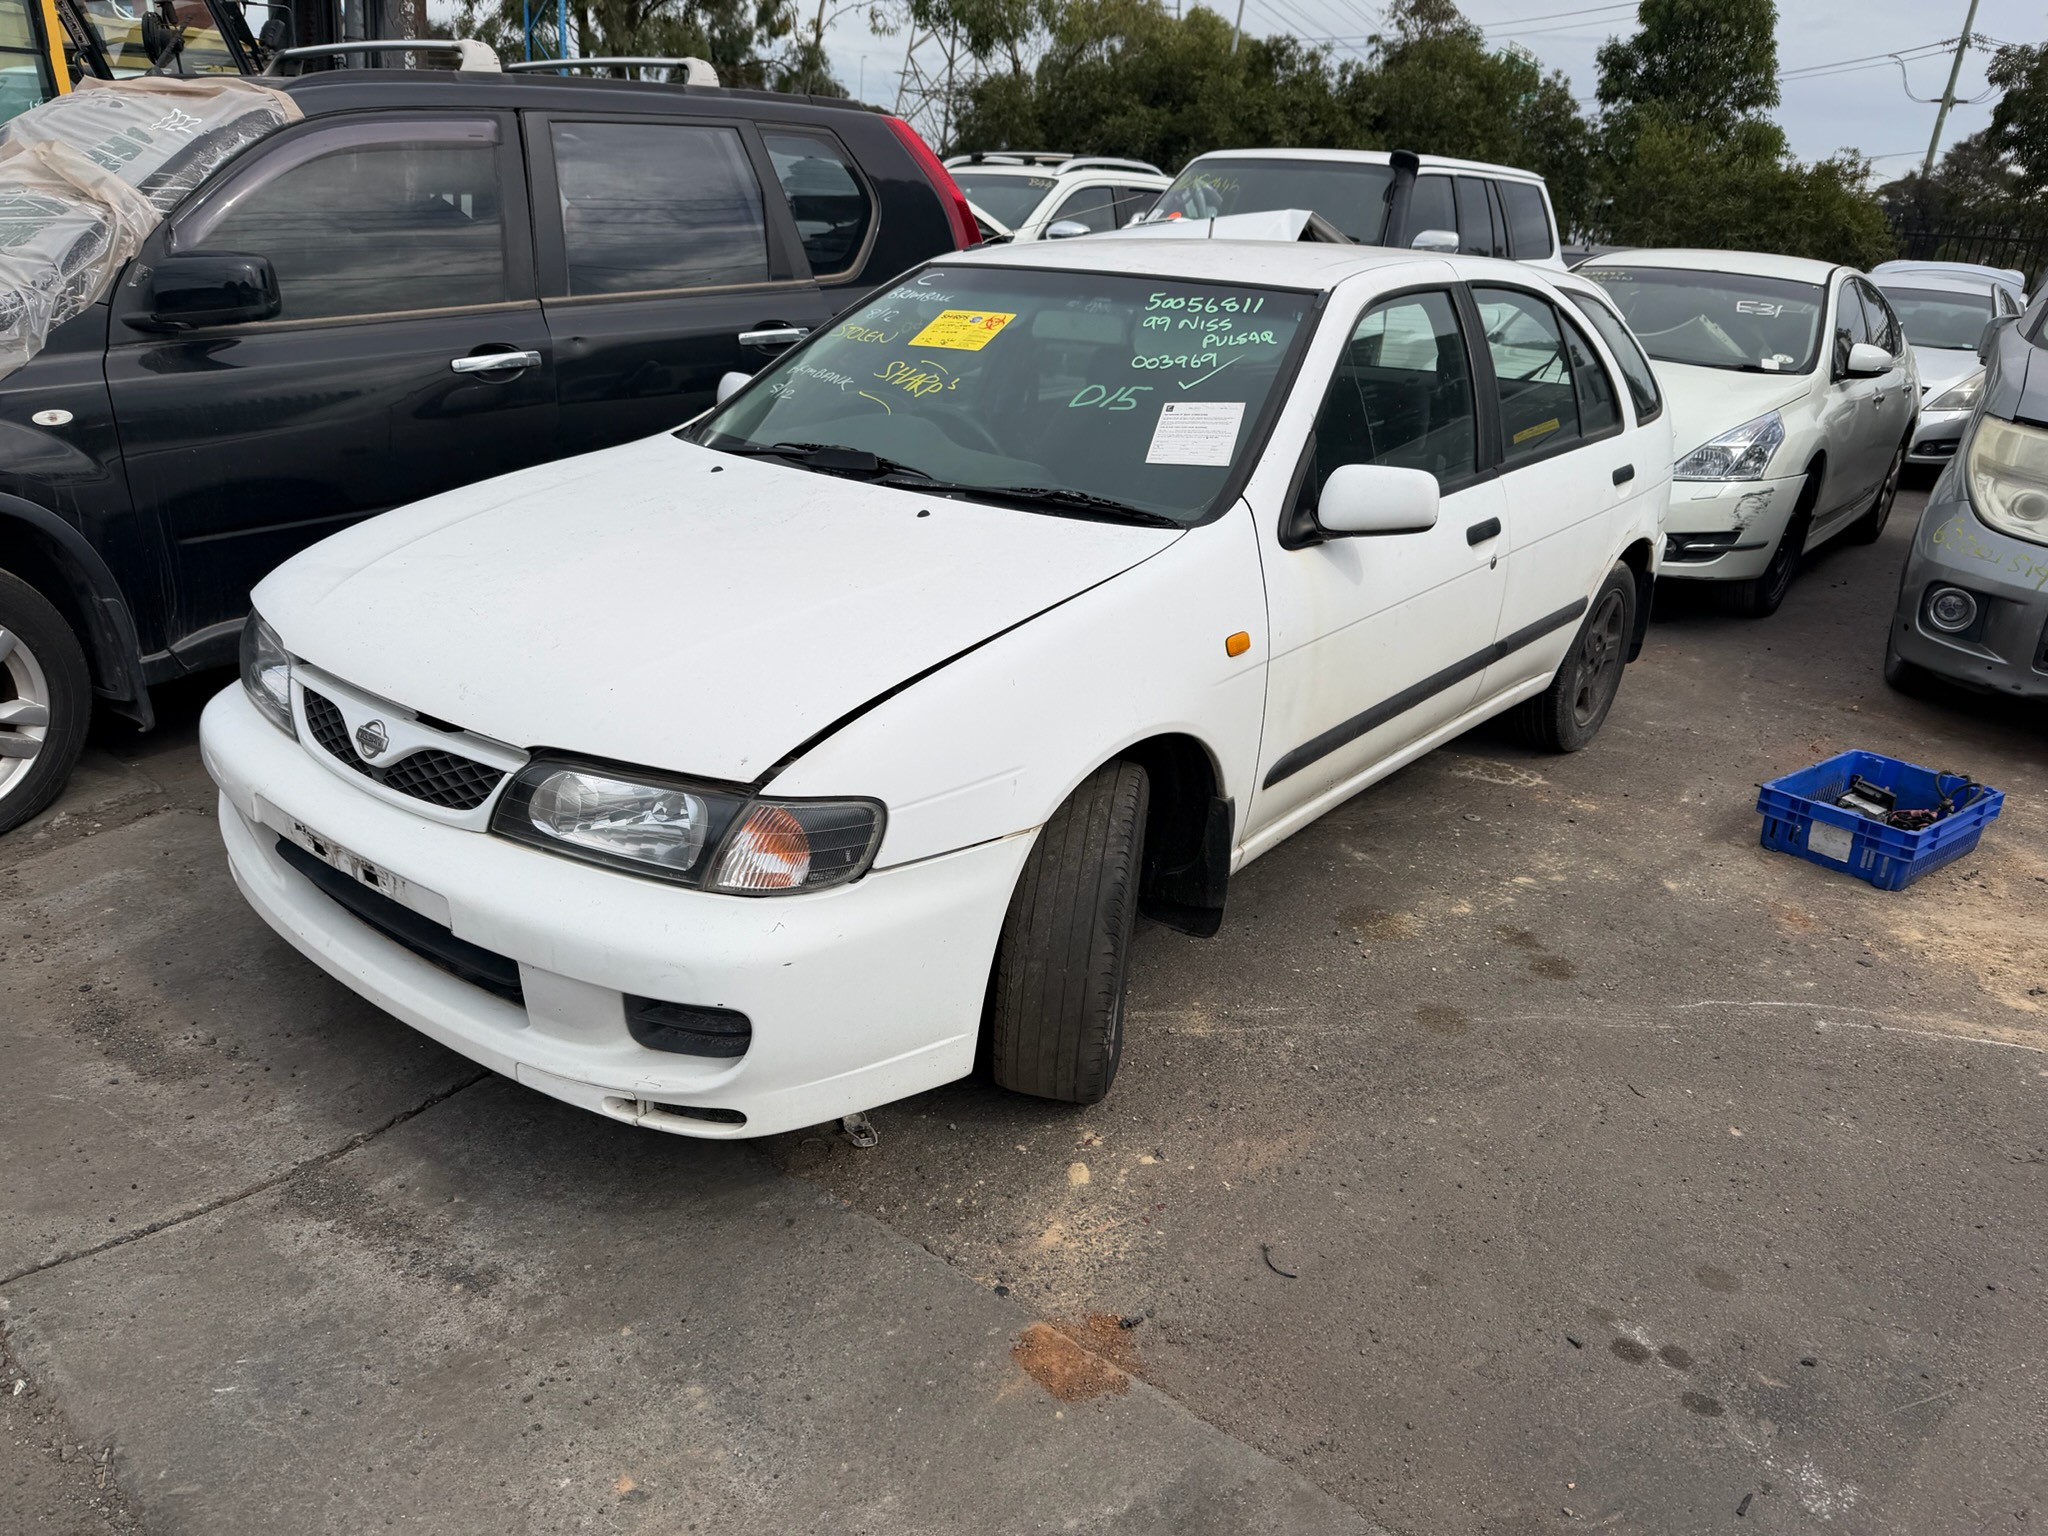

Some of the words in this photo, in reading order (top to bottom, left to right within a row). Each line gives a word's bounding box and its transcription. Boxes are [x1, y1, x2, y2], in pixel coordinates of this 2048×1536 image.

[1145, 292, 1265, 314] 50056811
[1736, 300, 1784, 319] E31
[831, 321, 899, 344] STOLEN
[1143, 315, 1172, 332] 99
[1178, 315, 1233, 332] NISS
[1131, 352, 1219, 370] 003969
